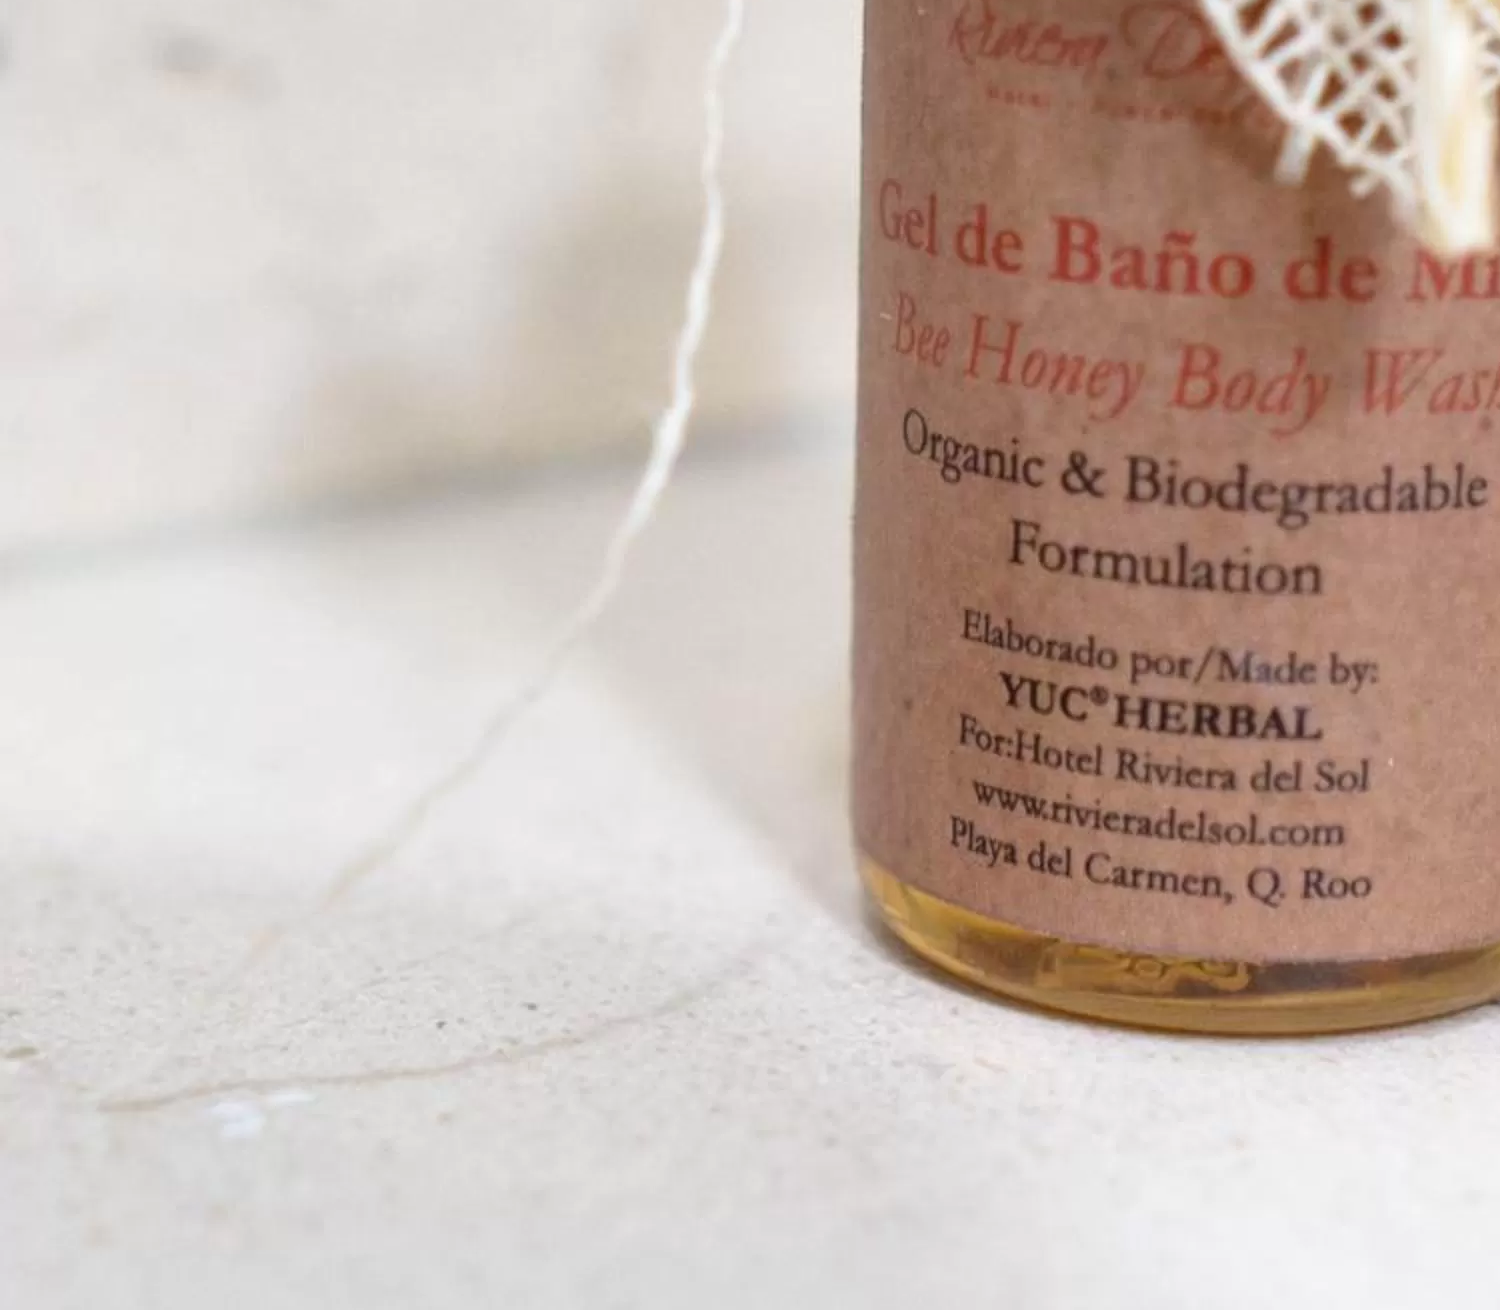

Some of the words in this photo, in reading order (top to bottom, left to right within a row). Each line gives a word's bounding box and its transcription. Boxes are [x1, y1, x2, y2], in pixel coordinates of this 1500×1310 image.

[879, 178, 938, 257] Gel
[955, 202, 1024, 274] de
[1048, 214, 1256, 300] Baño
[1282, 236, 1379, 302] de
[891, 290, 952, 368] Bee
[963, 313, 1147, 421] Honey
[1166, 340, 1331, 440] Body
[902, 407, 1046, 488] Organic
[1060, 450, 1106, 498] &
[1124, 454, 1488, 530] Biodegradable
[1009, 519, 1324, 595] Formulation
[961, 609, 1118, 671] Elaborado
[1130, 647, 1317, 687] por/Made
[1329, 652, 1379, 694] by:
[958, 713, 1103, 776] For:Hotel
[1116, 750, 1237, 791] Riviera
[1249, 759, 1302, 793] del
[1315, 759, 1370, 793] Sol
[1114, 697, 1324, 741] HERBAL
[972, 780, 1345, 847] www.rivieradelsol.com
[949, 815, 1018, 867] Playa
[1028, 840, 1073, 878] del
[1084, 853, 1234, 905] Carmen,
[1247, 869, 1285, 908] Q.
[1302, 869, 1372, 900] Roo
